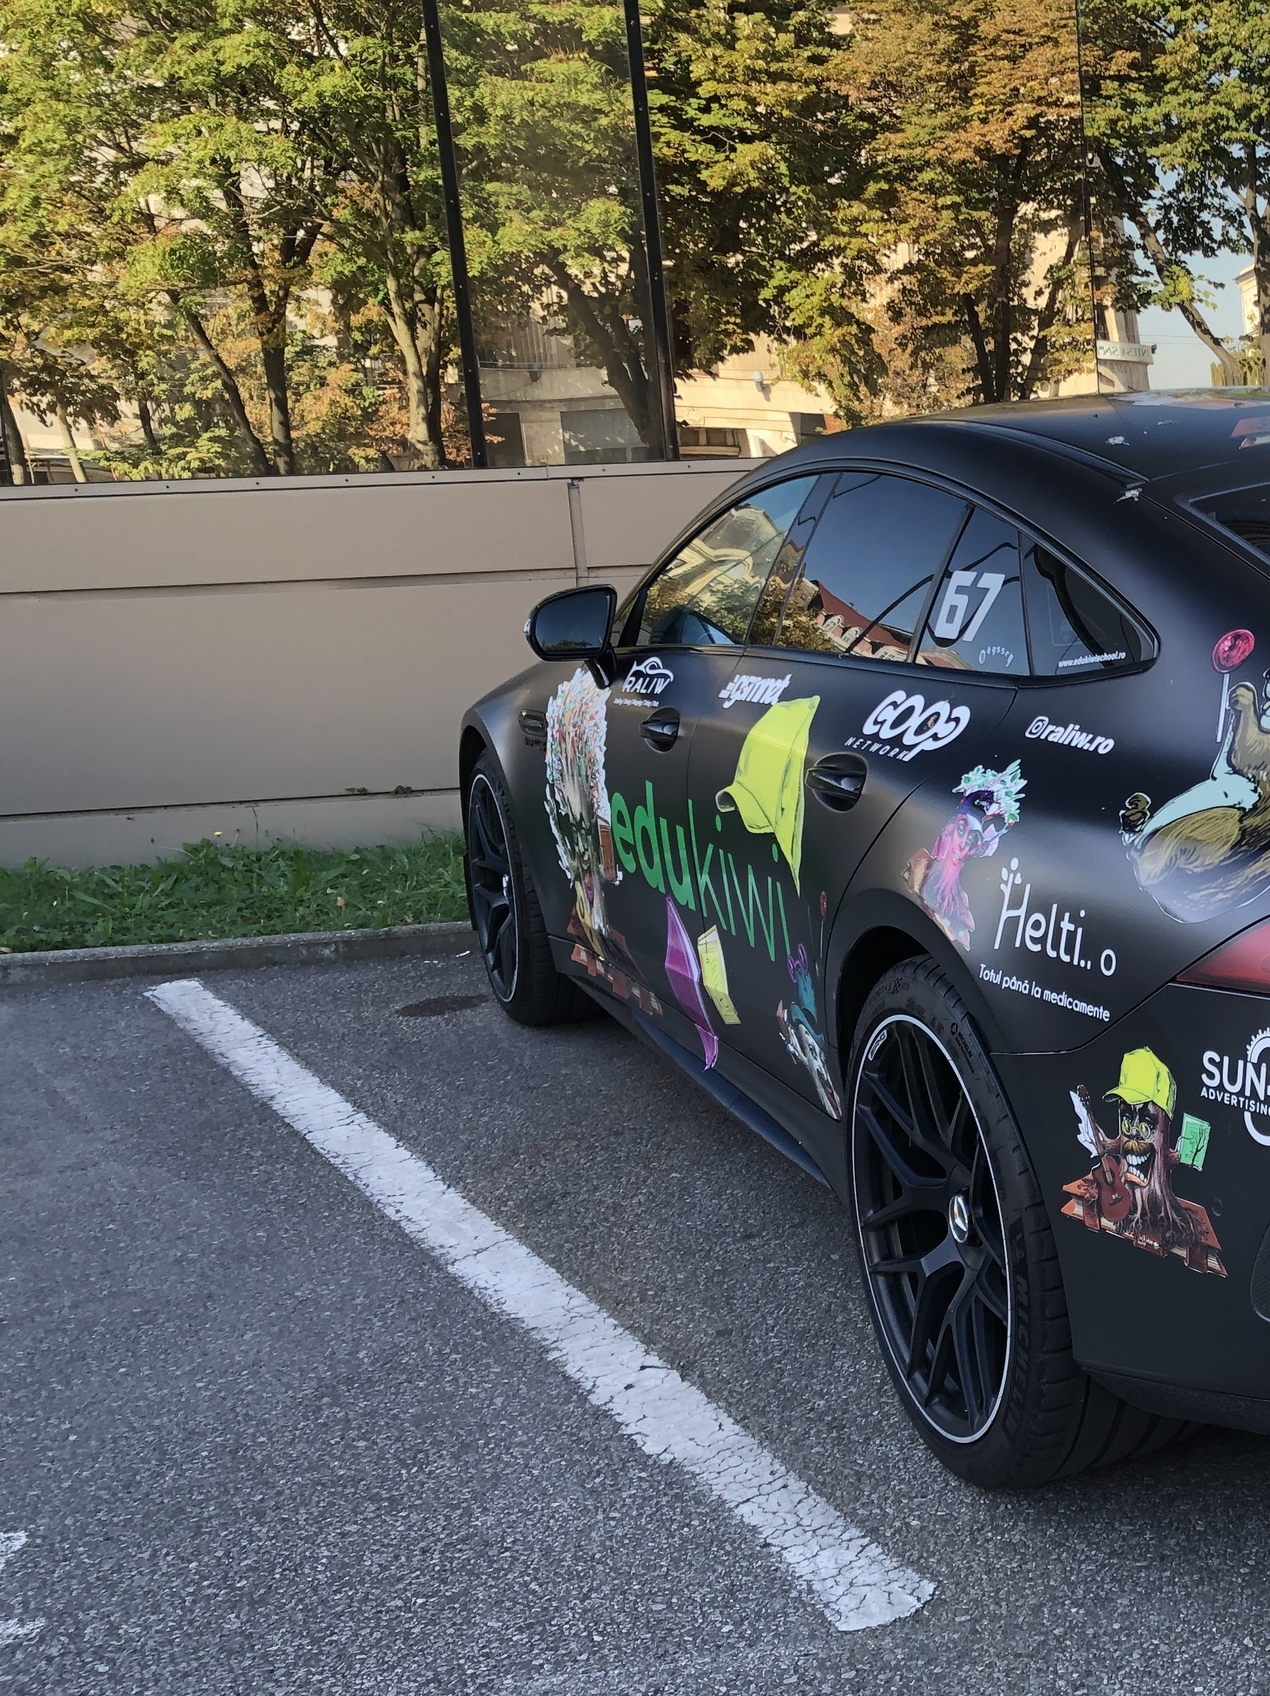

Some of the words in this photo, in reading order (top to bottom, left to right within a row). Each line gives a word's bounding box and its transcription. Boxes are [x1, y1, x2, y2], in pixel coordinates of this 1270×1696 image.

[934, 570, 1006, 642] 67
[622, 676, 672, 695] RALIW
[844, 736, 911, 761] NETWORK
[979, 963, 1001, 985] Totul
[1002, 976, 1029, 994] până
[1031, 980, 1041, 998] la
[1043, 989, 1111, 1022] medicamente
[1201, 1050, 1267, 1099] SUN
